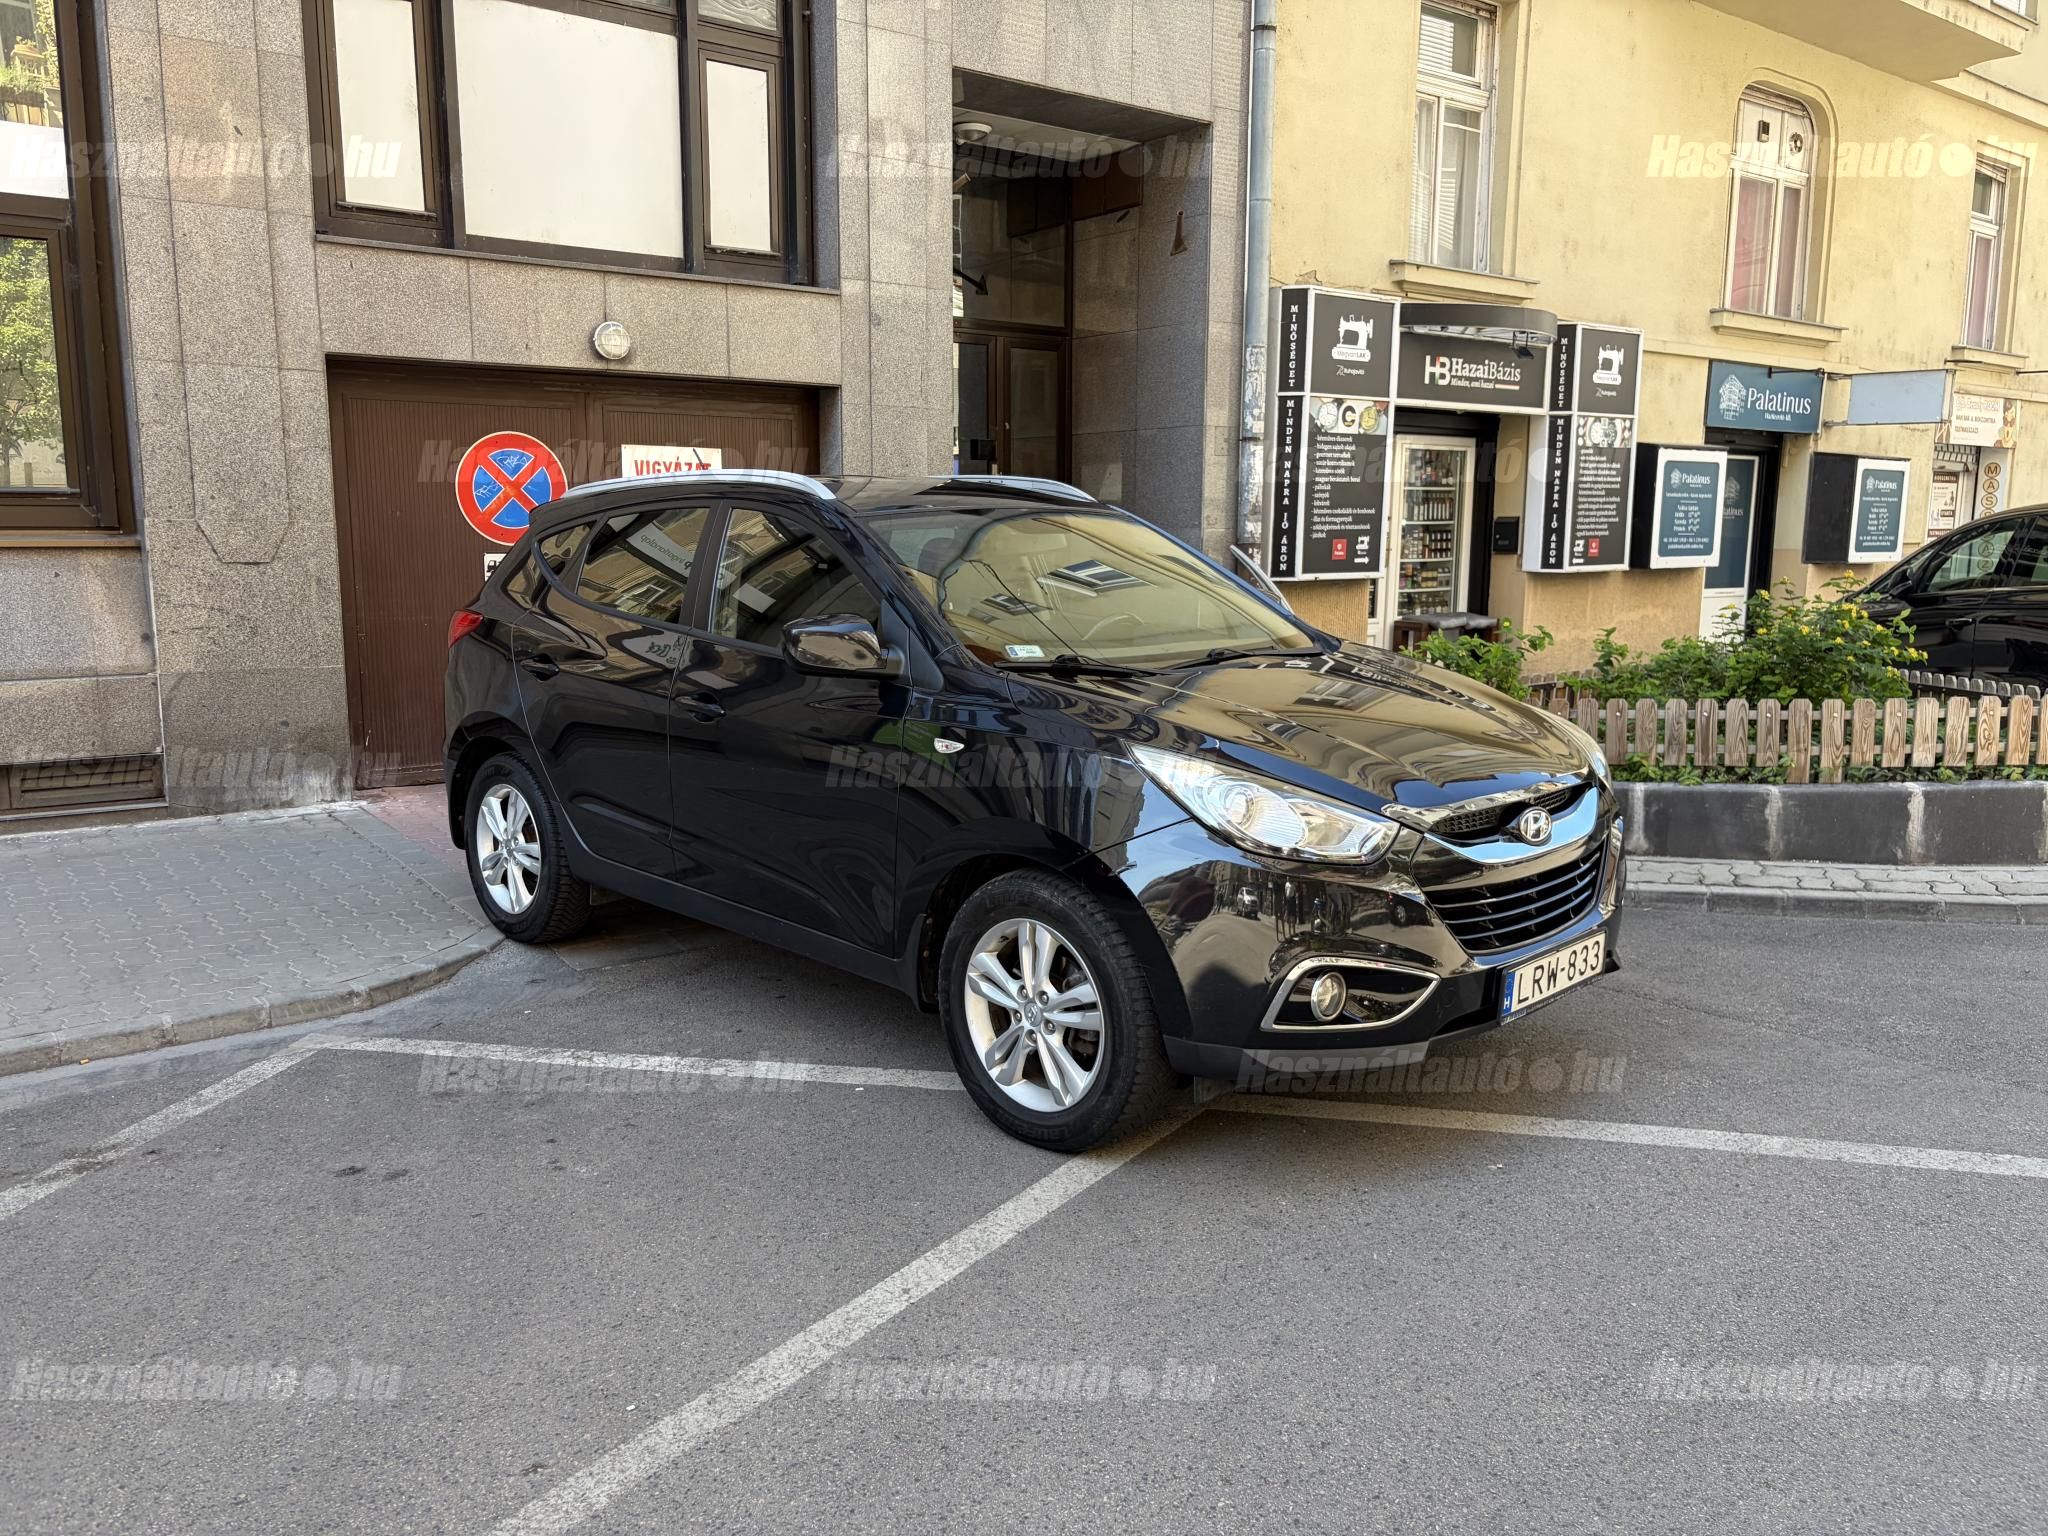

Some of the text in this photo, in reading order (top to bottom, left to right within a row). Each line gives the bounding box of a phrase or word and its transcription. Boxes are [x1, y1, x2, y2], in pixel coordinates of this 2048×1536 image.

[1451, 358, 1521, 382] HazaiBázis
[1747, 387, 1812, 414] Palatinus
[1285, 400, 1295, 453] MINDEN
[1555, 418, 1565, 464] MINDEN
[1282, 461, 1292, 504] NAPRA
[1552, 470, 1561, 508] NAPRA
[1682, 472, 1711, 485] Palatinus
[1280, 535, 1288, 571] ÁRON
[1503, 940, 1601, 1010] H LRW-833
